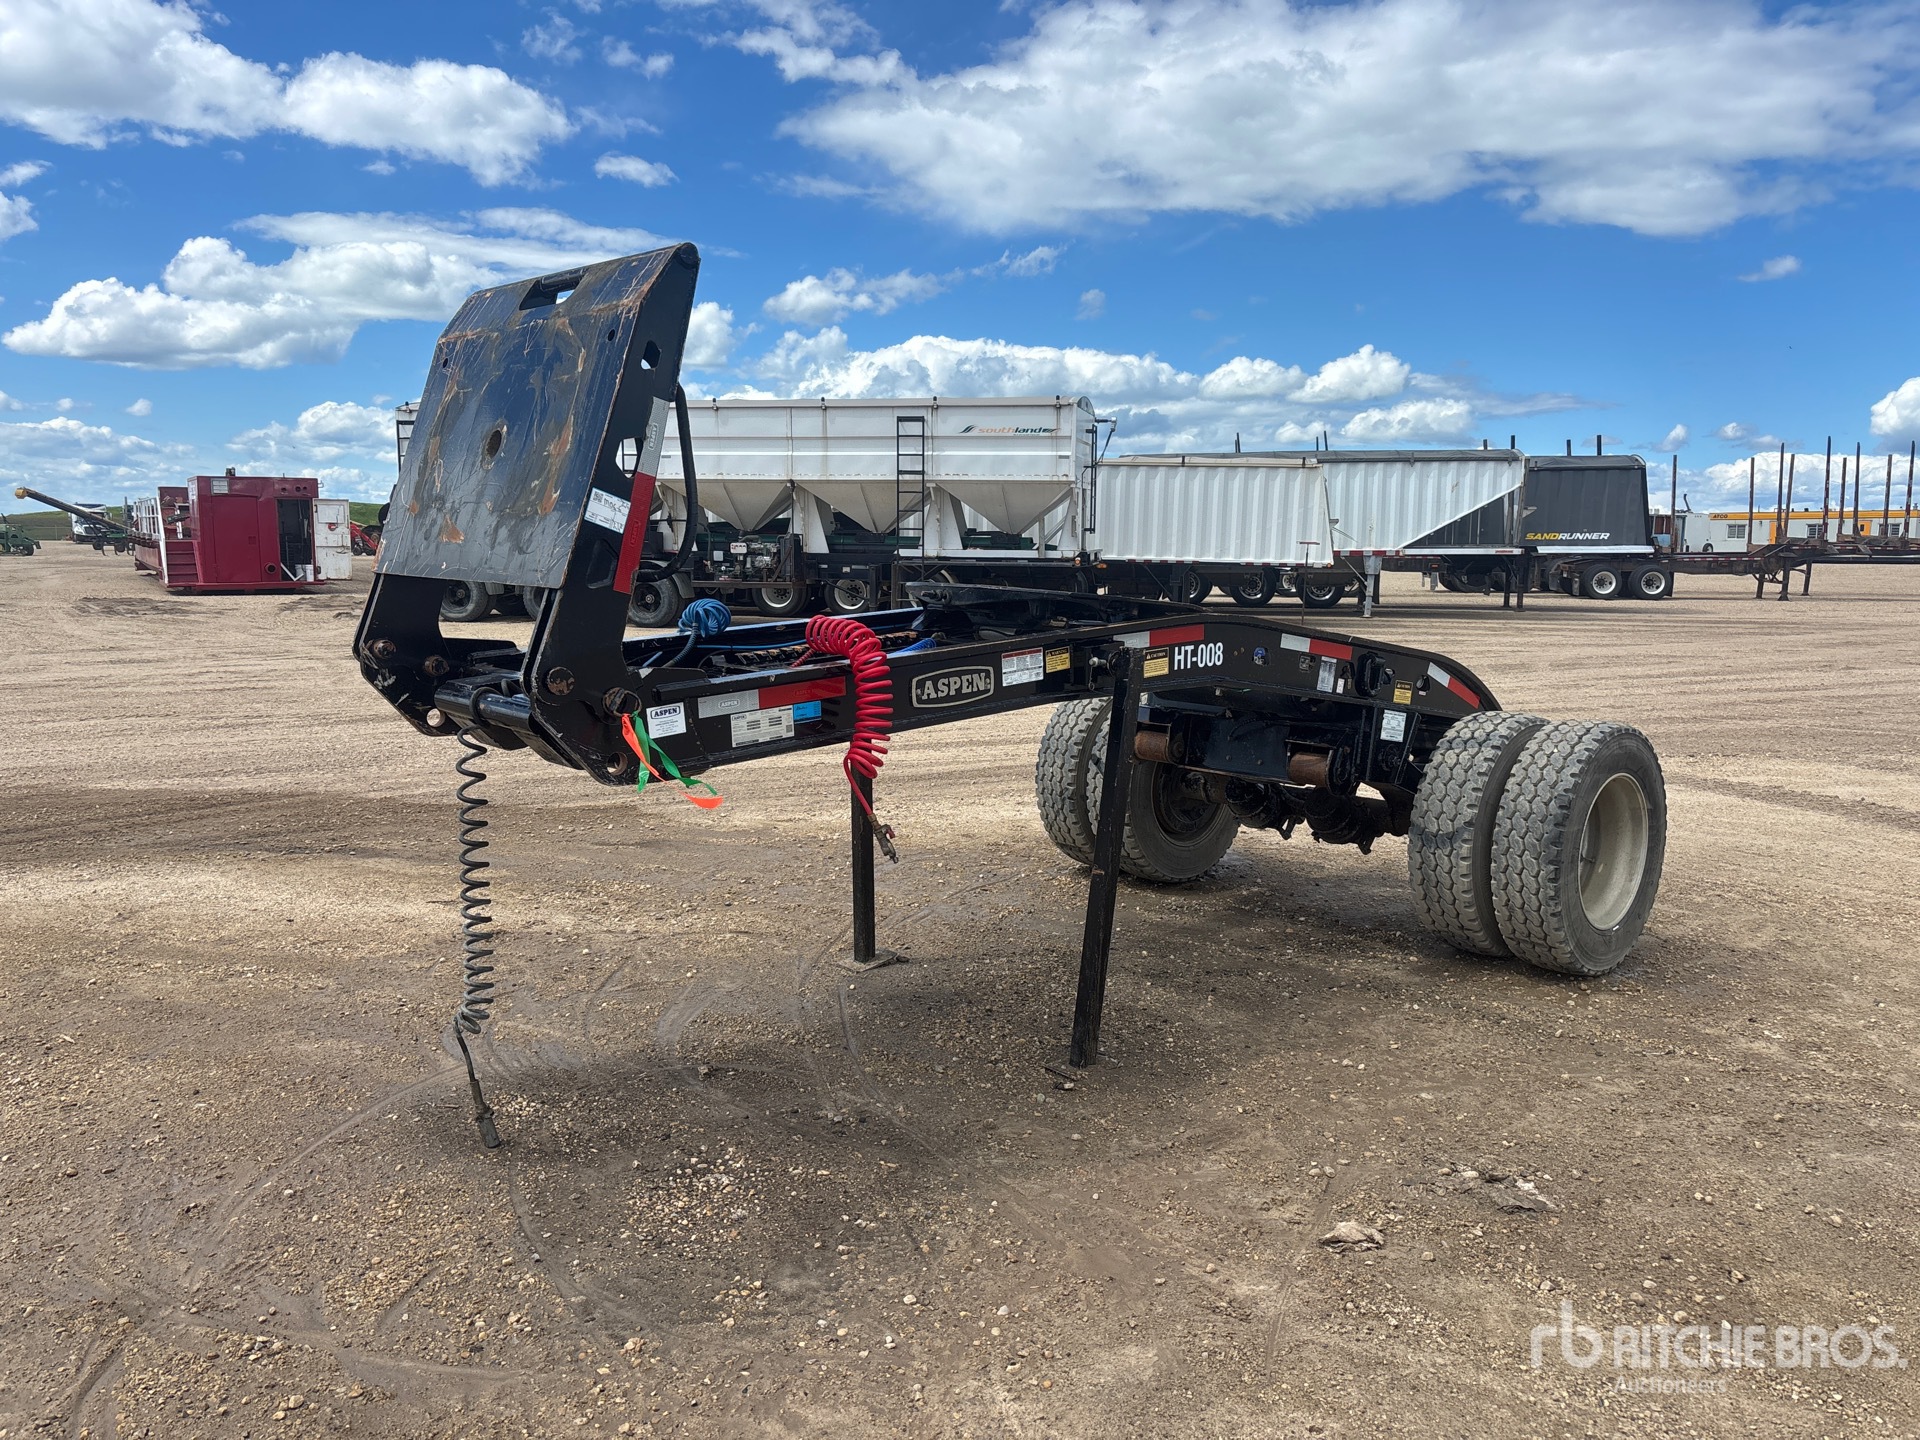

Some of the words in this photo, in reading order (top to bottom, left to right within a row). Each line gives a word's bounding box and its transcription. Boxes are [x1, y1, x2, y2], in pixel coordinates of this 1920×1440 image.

[1525, 532, 1610, 540] SANDRUNNER
[1174, 642, 1223, 670] HT-008
[922, 672, 986, 700] ASPEN
[720, 700, 738, 708] ASPEN
[654, 707, 678, 717] ASPEN
